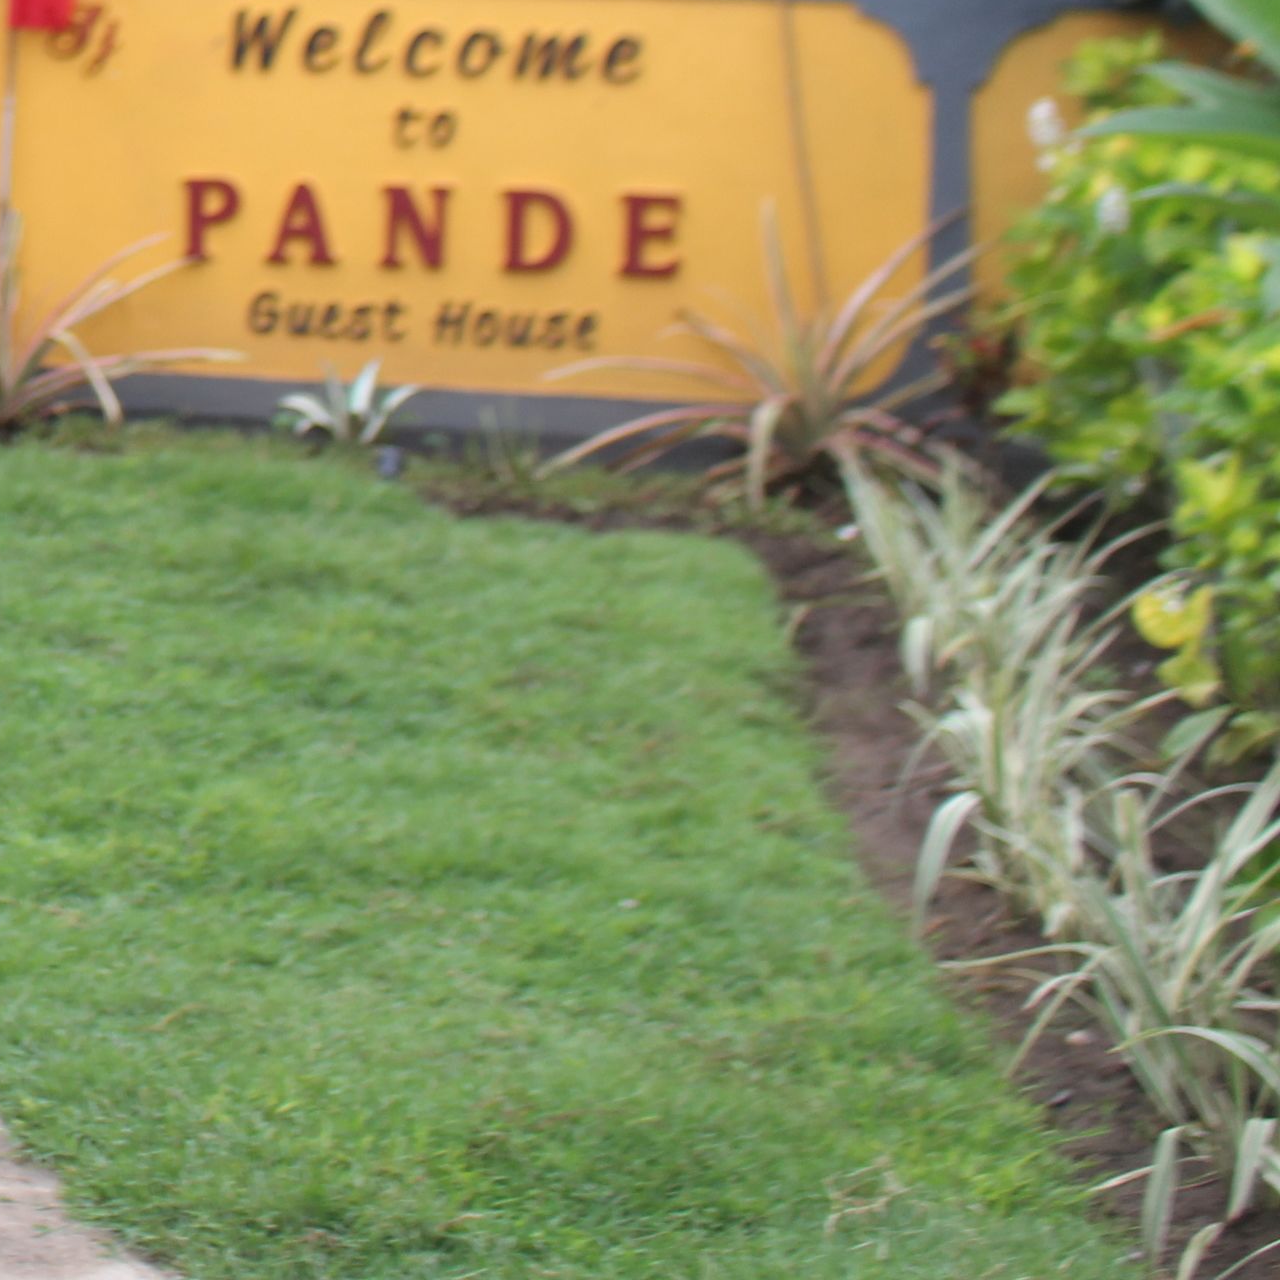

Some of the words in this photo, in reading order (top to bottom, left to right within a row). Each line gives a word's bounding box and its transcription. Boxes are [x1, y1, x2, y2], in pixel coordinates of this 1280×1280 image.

[229, 7, 645, 86] Welcome
[394, 106, 458, 150] to
[184, 178, 683, 280] PANDE
[247, 290, 406, 345] Guest
[433, 304, 599, 353] House
